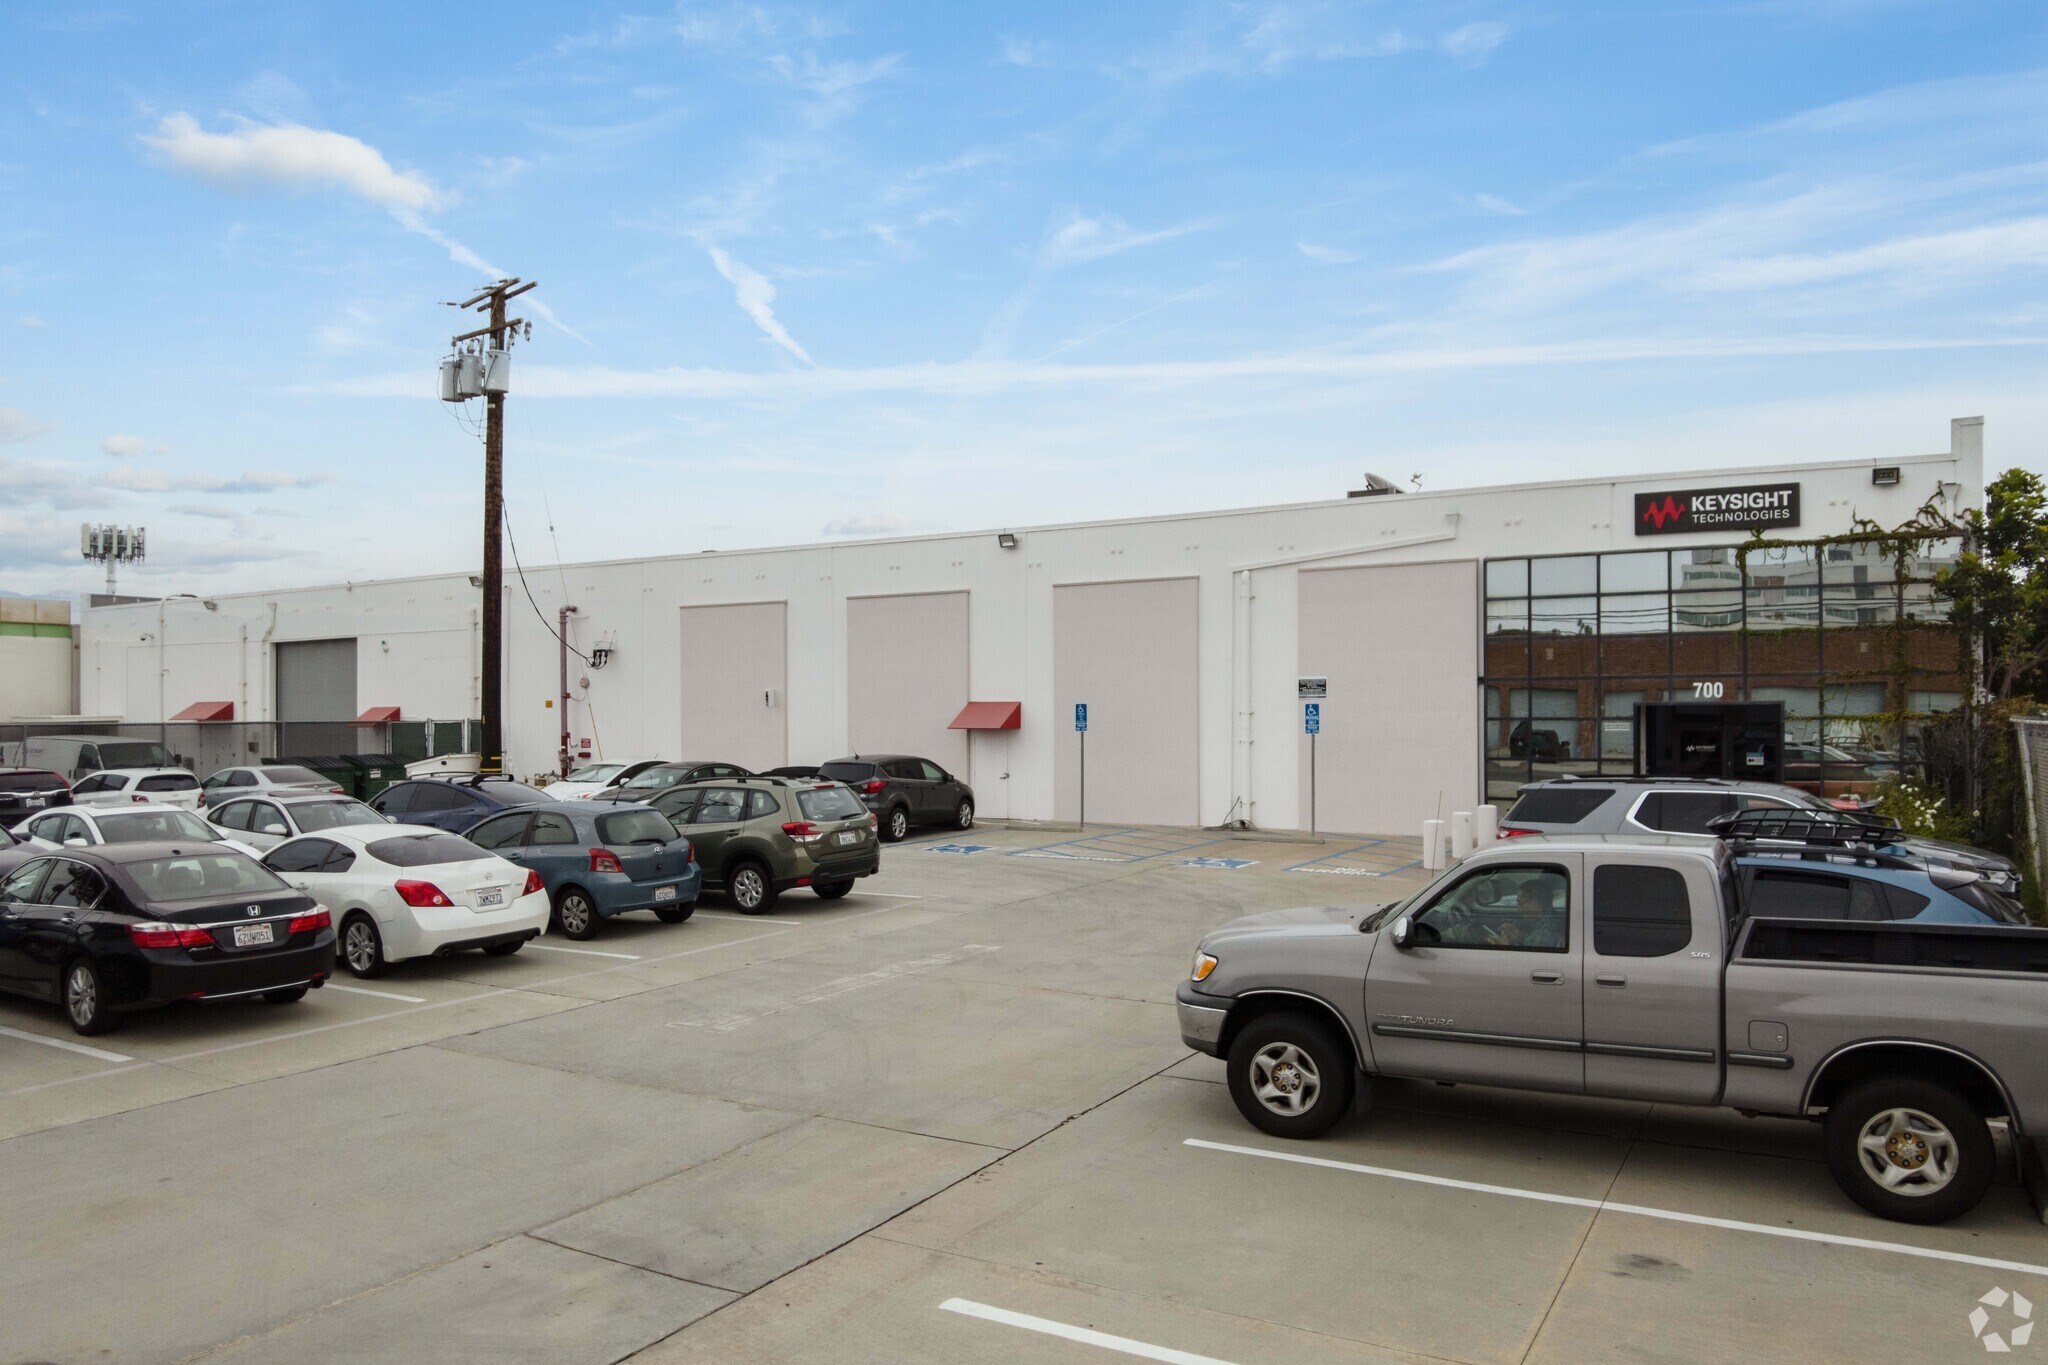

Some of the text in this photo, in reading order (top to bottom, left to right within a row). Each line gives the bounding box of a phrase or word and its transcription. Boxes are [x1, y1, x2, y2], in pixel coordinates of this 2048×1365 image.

[1691, 490, 1793, 512] KEYSIGHT
[1692, 509, 1790, 523] TECHNOLOGIES
[1692, 682, 1724, 698] 700
[237, 931, 270, 943] 6ZUW051
[1401, 1015, 1455, 1026] TUNDRA
